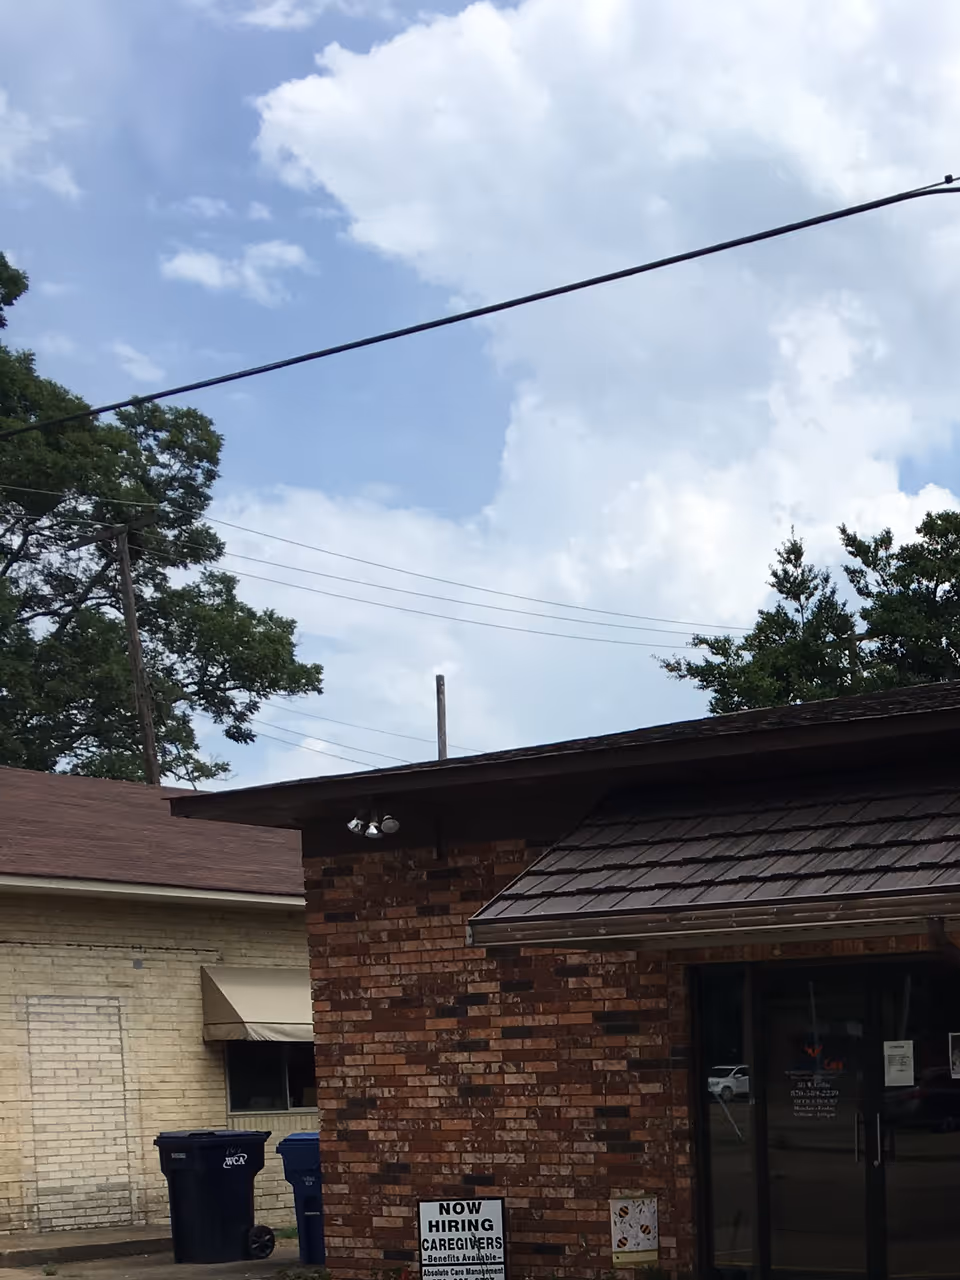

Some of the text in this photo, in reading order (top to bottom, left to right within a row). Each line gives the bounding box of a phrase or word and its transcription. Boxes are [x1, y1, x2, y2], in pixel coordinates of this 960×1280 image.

[225, 1156, 245, 1165] WCA
[438, 1201, 482, 1215] NOW
[428, 1218, 494, 1233] HIRING
[421, 1236, 503, 1251] CAREGIVERS
[423, 1267, 504, 1276] Absolute Care Management
